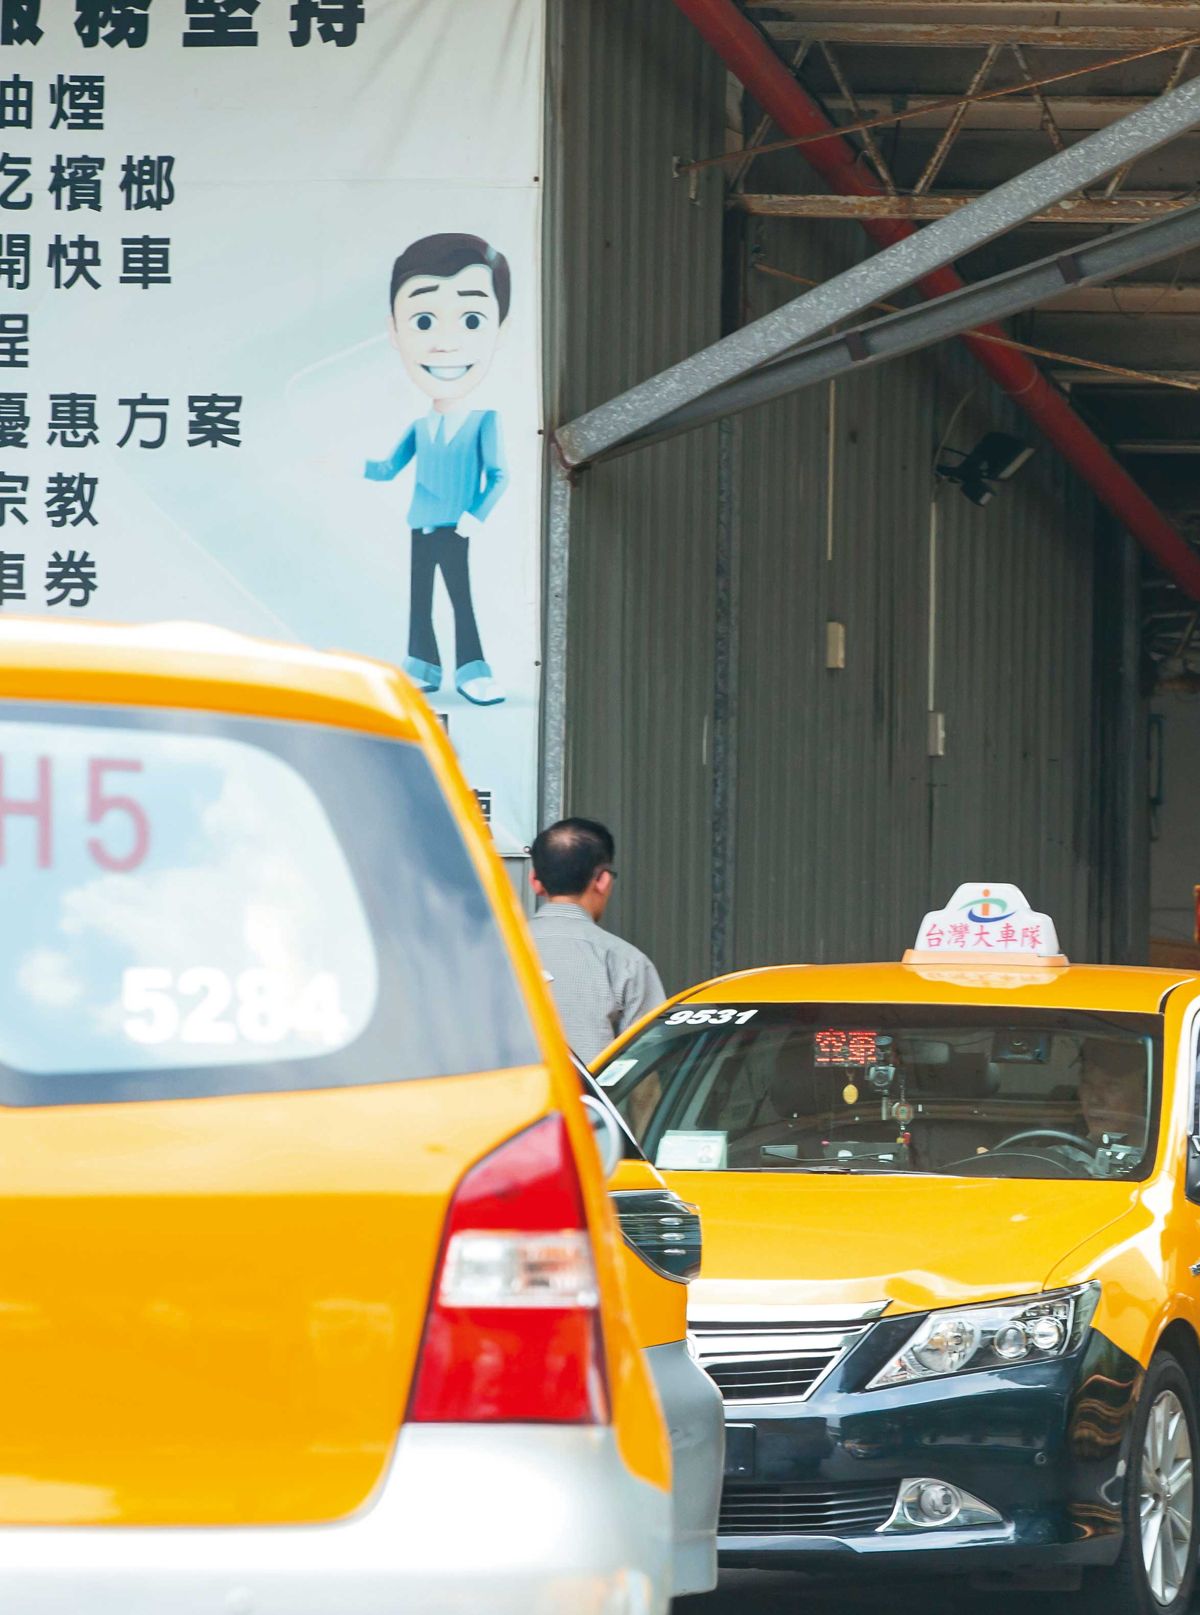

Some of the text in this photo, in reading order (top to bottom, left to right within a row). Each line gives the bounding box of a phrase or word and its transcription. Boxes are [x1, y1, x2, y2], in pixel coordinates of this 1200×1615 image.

[925, 922, 1043, 949] 台灣大車隊
[121, 965, 349, 1046] 5284
[664, 1009, 759, 1026] 9531
